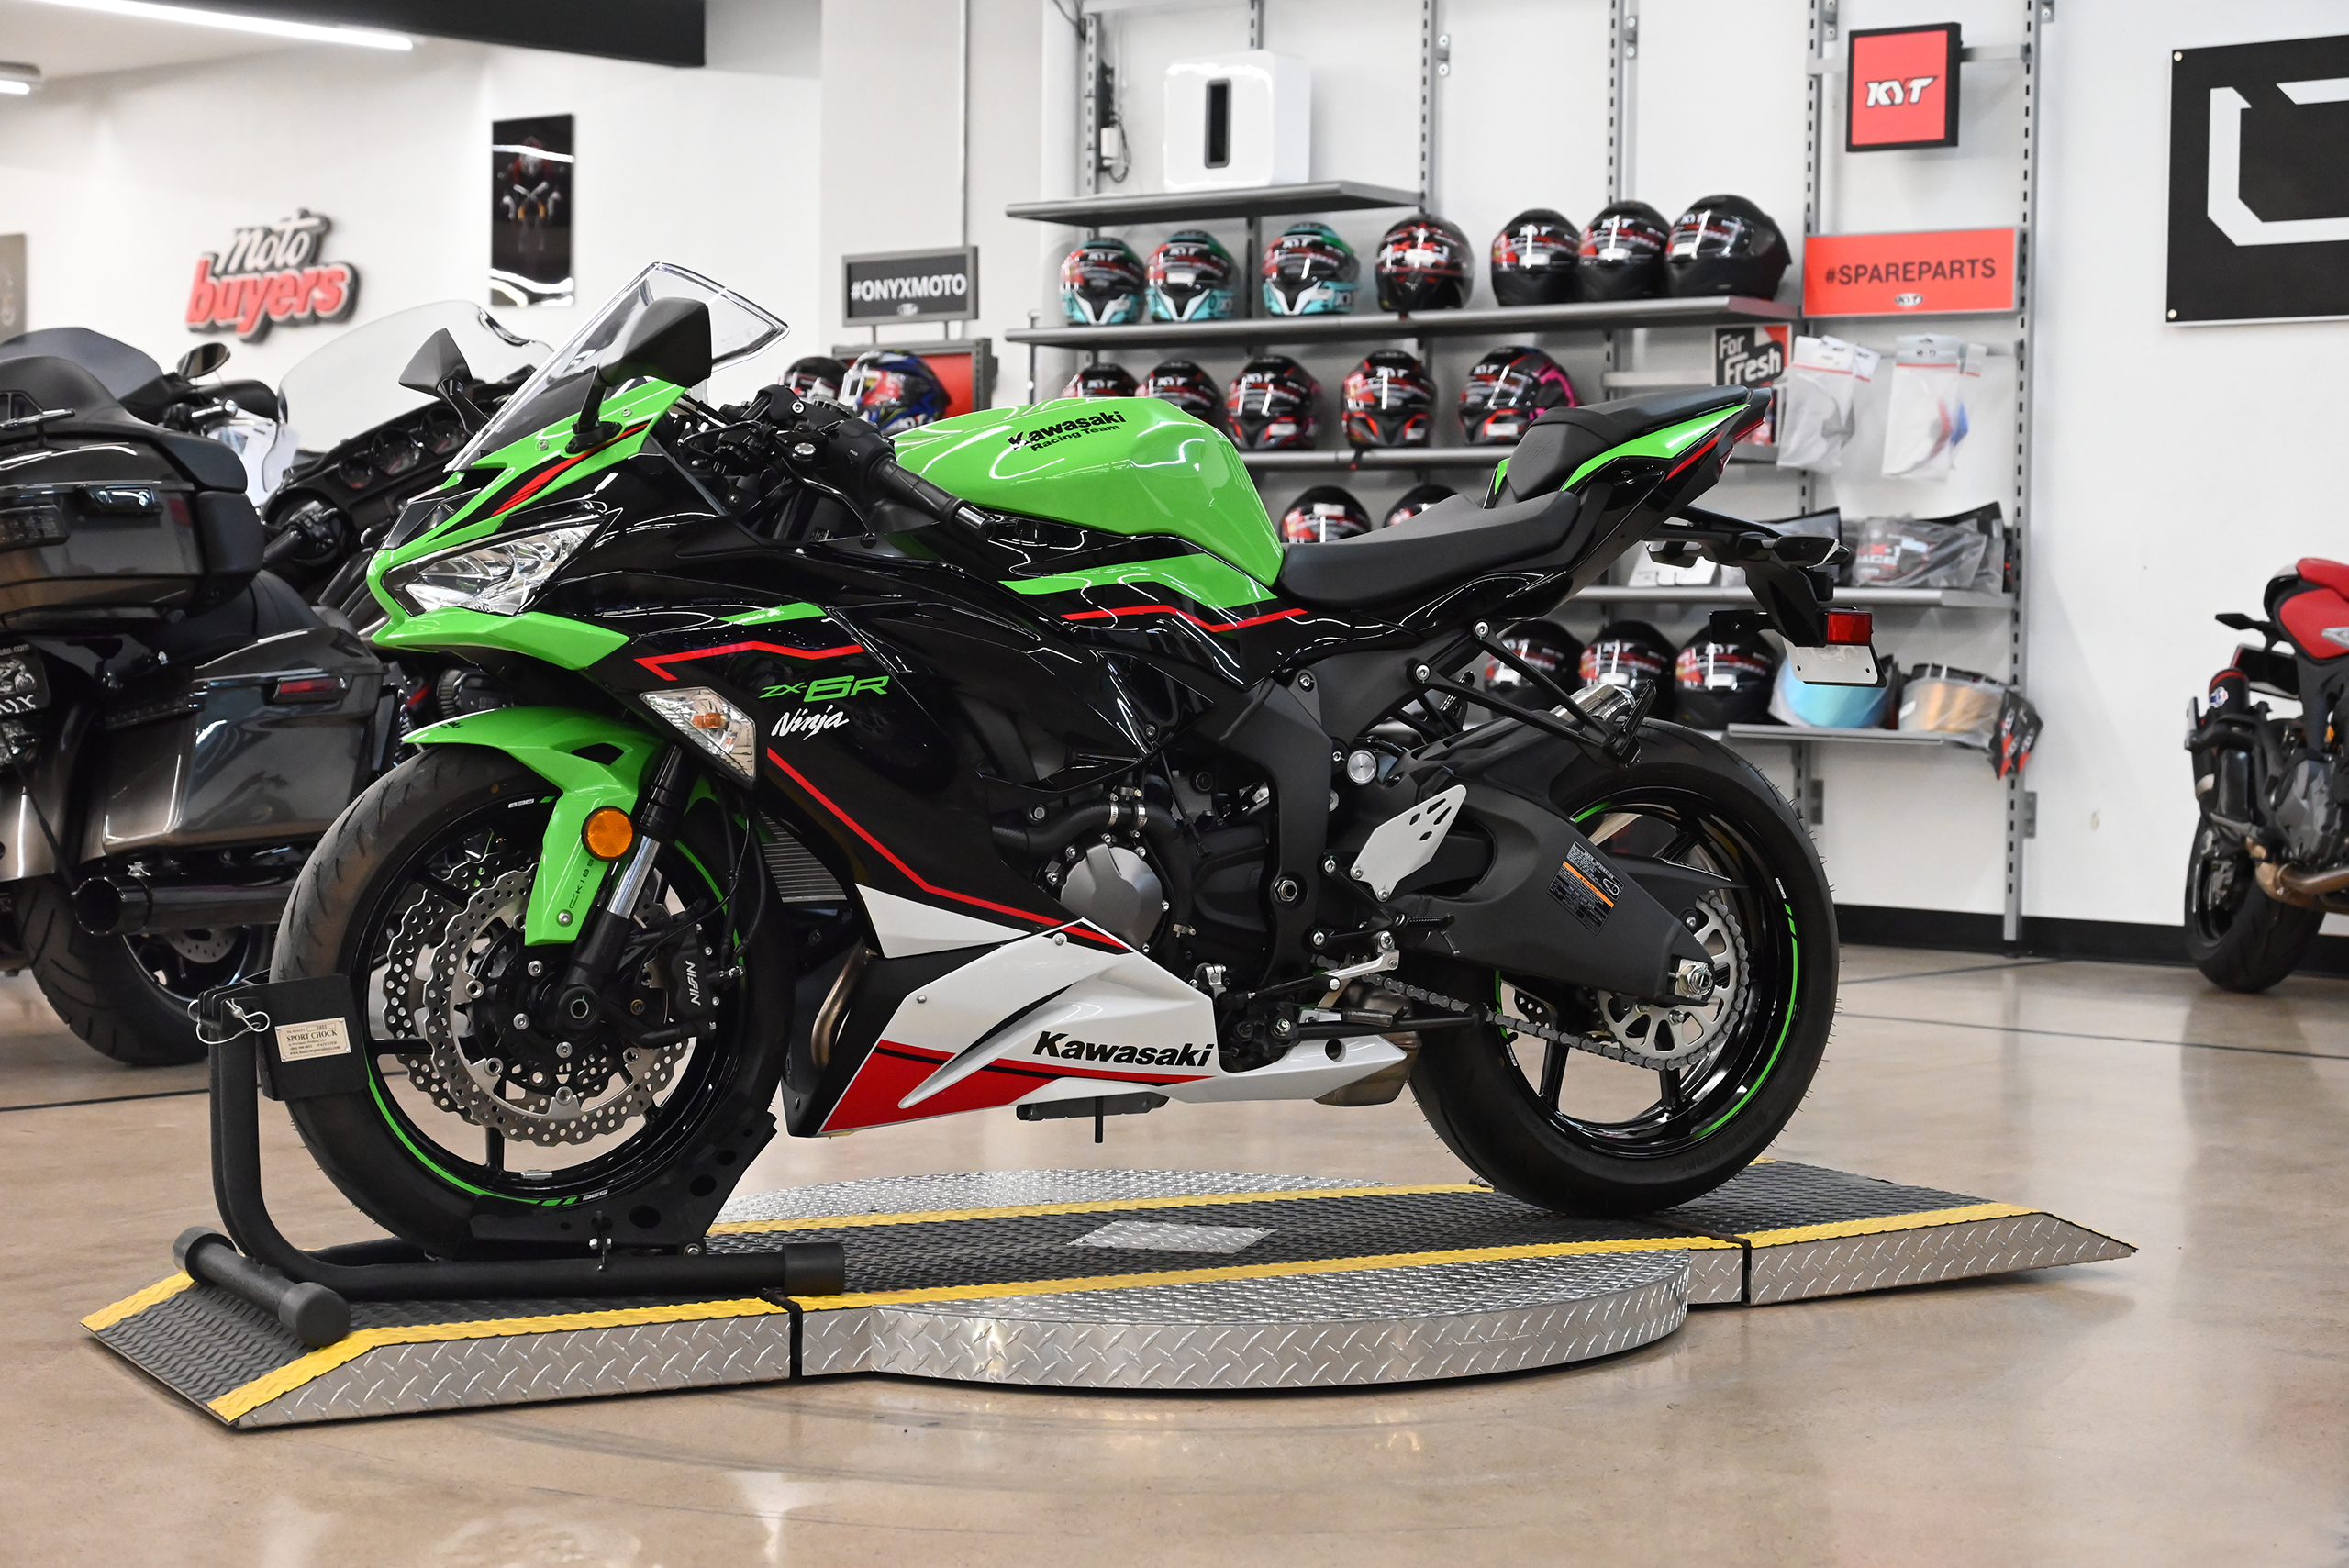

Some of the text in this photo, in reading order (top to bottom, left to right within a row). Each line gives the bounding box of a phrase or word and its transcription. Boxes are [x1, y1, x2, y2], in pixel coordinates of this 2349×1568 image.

[1865, 75, 1939, 107] KYT
[1825, 257, 1997, 286] #SPAREPARTS
[186, 258, 348, 334] buyers
[851, 273, 967, 302] #ONYXMOTO
[1719, 334, 1746, 360] For
[1725, 347, 1782, 385] Fresh
[1007, 411, 1127, 450] Kawasaki
[1030, 424, 1120, 451] Racing Team
[758, 675, 890, 703] ZX-6R
[771, 704, 850, 741] Ninja
[286, 1029, 338, 1042] SPORT CHOCK
[1032, 1030, 1216, 1067] Kawasaki
